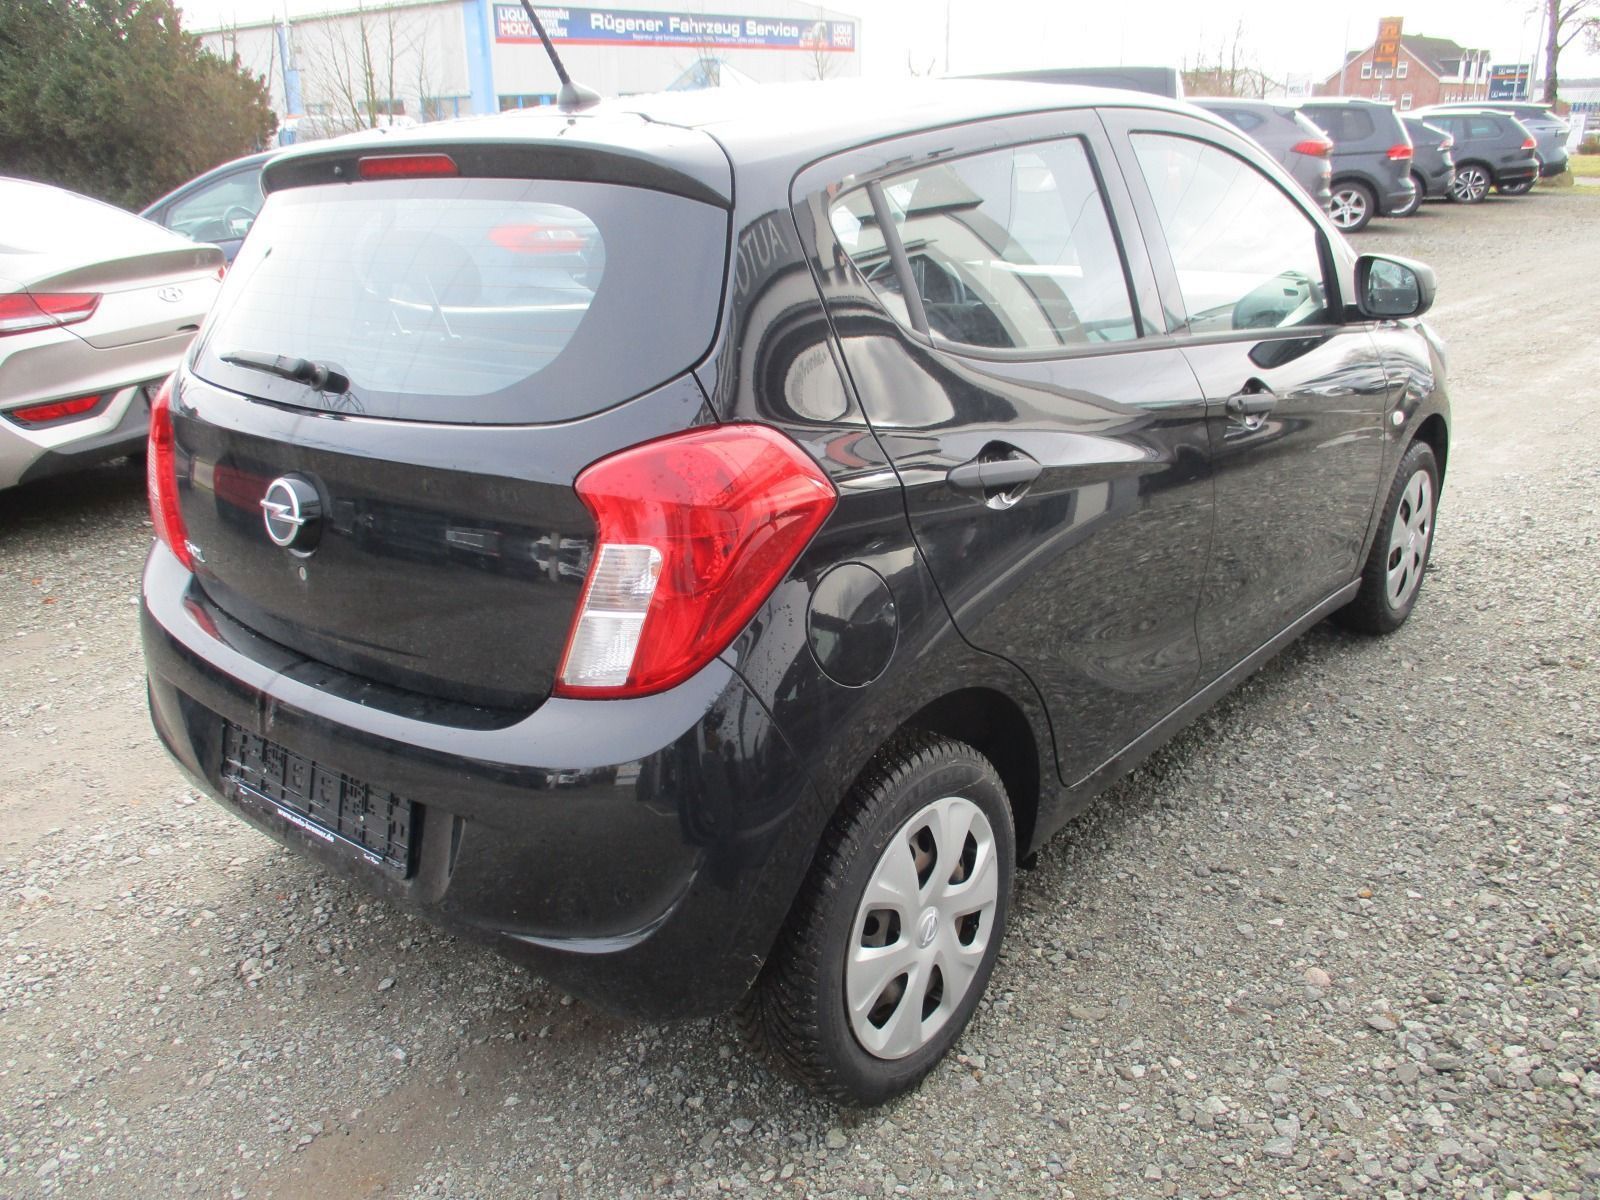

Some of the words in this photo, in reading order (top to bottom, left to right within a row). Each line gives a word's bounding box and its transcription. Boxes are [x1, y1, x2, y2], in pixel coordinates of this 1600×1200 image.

[500, 22, 531, 35] MOLY
[590, 13, 664, 33] Rügener
[669, 16, 740, 37] Fahrzeug
[746, 20, 799, 37] Service
